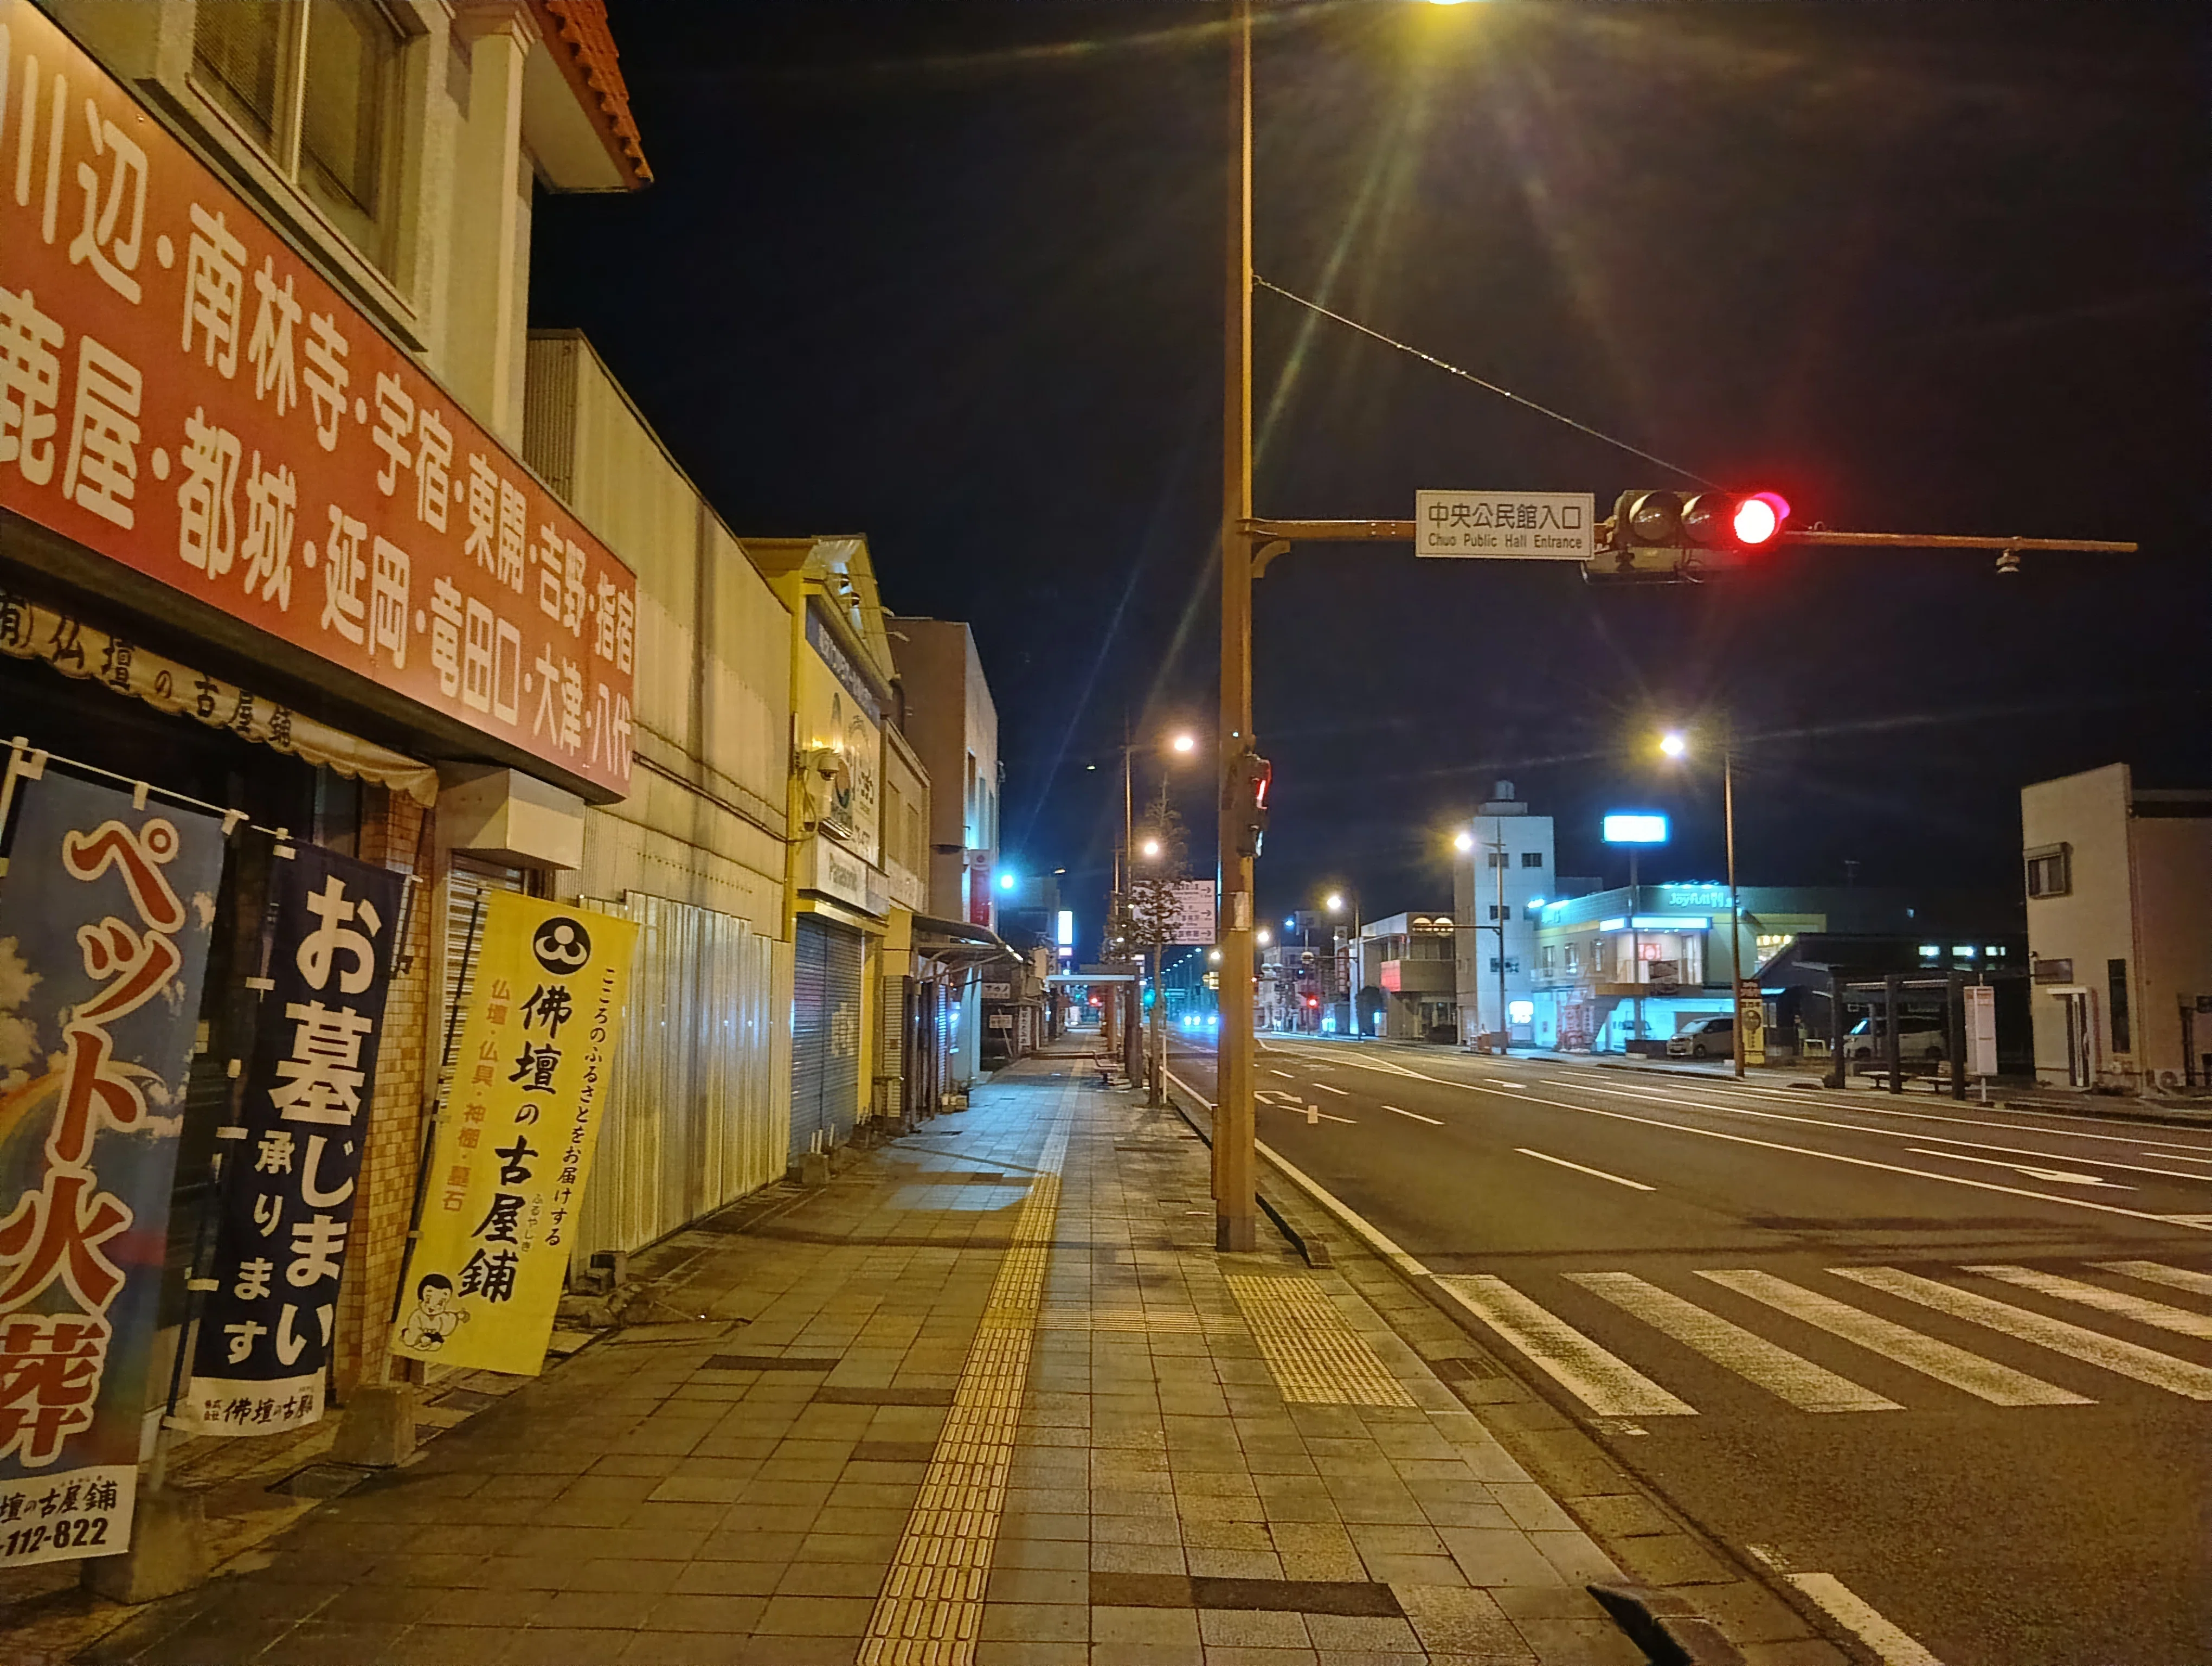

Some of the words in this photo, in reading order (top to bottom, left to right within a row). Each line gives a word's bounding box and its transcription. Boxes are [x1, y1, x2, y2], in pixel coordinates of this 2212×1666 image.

[1428, 502, 1581, 530] 中央公民館入口
[1428, 533, 1456, 547] Chuo
[1464, 533, 1497, 548] Public
[1504, 534, 1527, 548] Hall
[1534, 534, 1583, 549] Entrance
[0, 818, 185, 1468] ペット火葬
[268, 874, 382, 1366] お墓じまい
[521, 1193, 544, 1253] ふるやしき
[545, 968, 616, 1246] こころのふるさとをお届けする
[223, 1130, 295, 1364] 承ります
